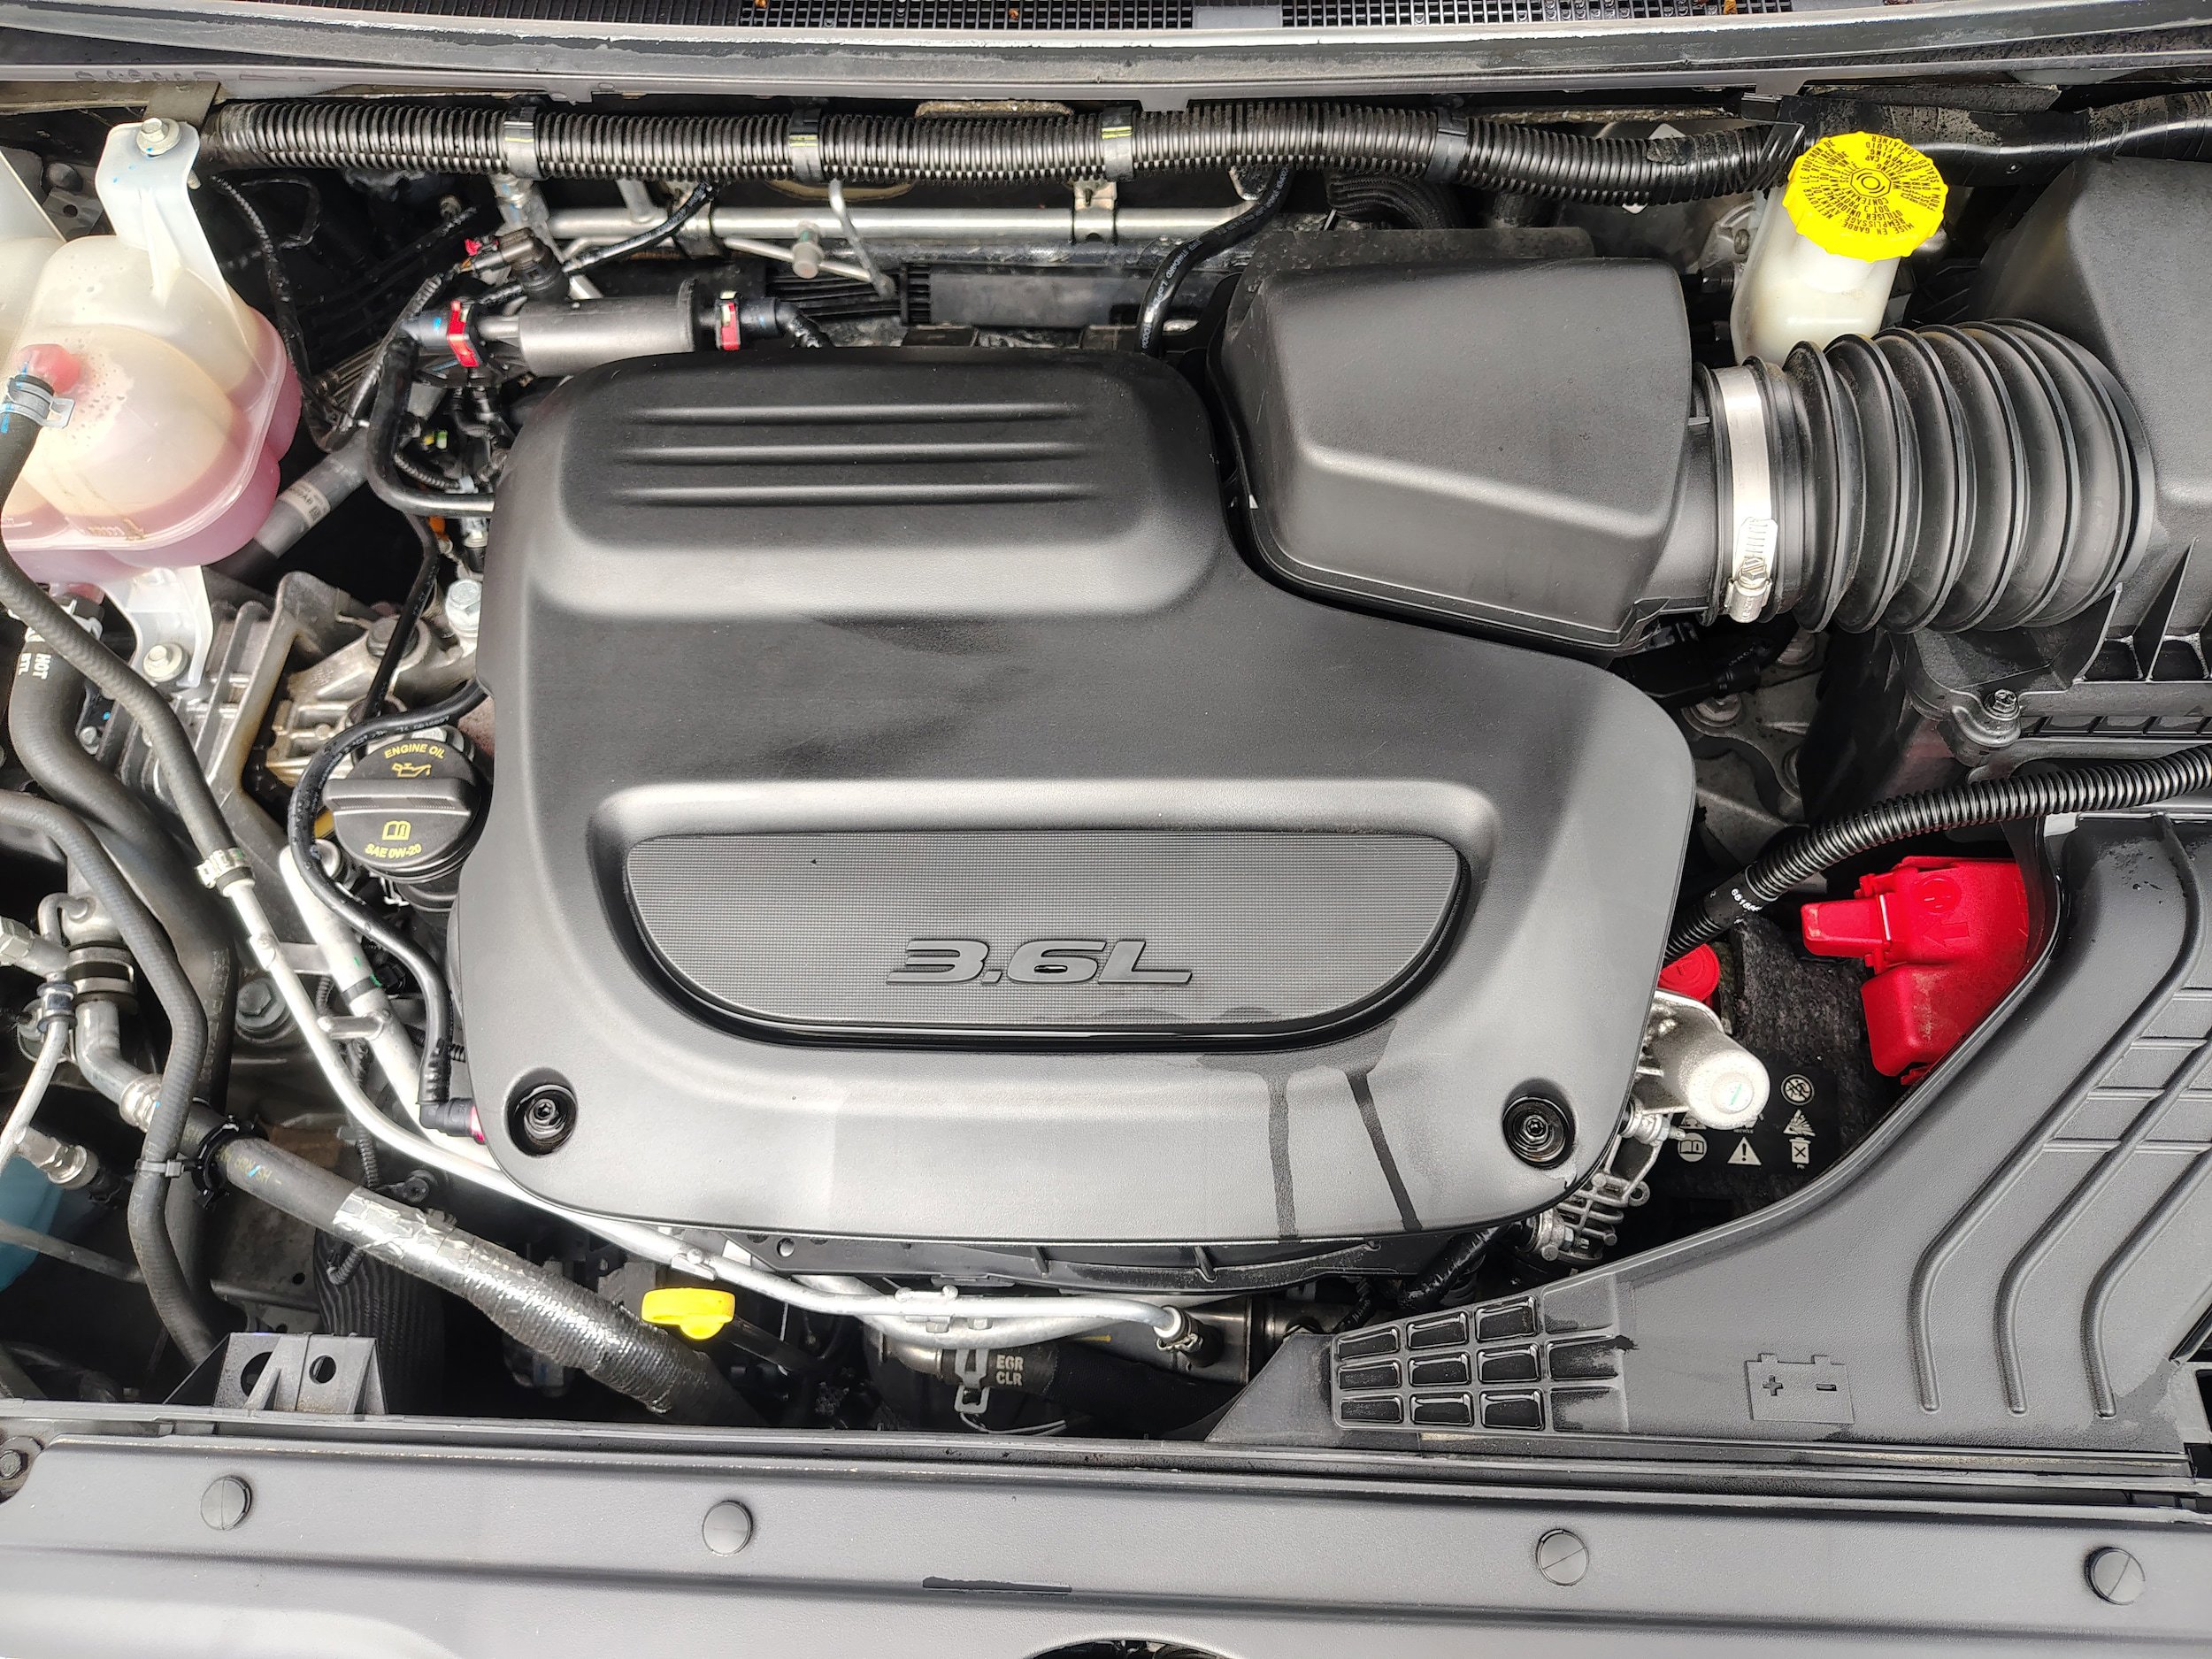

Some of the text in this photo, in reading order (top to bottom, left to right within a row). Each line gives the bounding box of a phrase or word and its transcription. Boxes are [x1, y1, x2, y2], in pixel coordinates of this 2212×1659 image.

[1865, 142, 1894, 153] FLUID
[1869, 134, 1919, 158] CONTAINER.
[1801, 147, 1824, 172] BOUCHON
[1823, 151, 1850, 170] LIQUIDE
[1906, 158, 1922, 171] DOT
[1917, 159, 1939, 183] SEALED
[1819, 184, 1862, 218] UNIQUEMENT
[1830, 175, 1860, 209] PROVENANT
[1840, 187, 1889, 205] CONTENANT
[1803, 188, 1834, 219] NETTOYER
[1817, 196, 1841, 215] AVANT
[1874, 204, 1890, 213] DOT
[1927, 194, 1941, 211] FROM
[1844, 214, 1905, 228] REMPLISSAGE
[1866, 210, 1903, 221] UTILISER
[1894, 222, 1916, 234] MISE
[18, 652, 32, 676] BTL
[32, 653, 51, 680] HOT
[383, 743, 446, 759] ENGINE OIL
[365, 843, 423, 859] SAE 0W-20
[886, 938, 1193, 986] 3.6L
[996, 1354, 1025, 1371] EGR
[995, 1371, 1023, 1386] CLR
